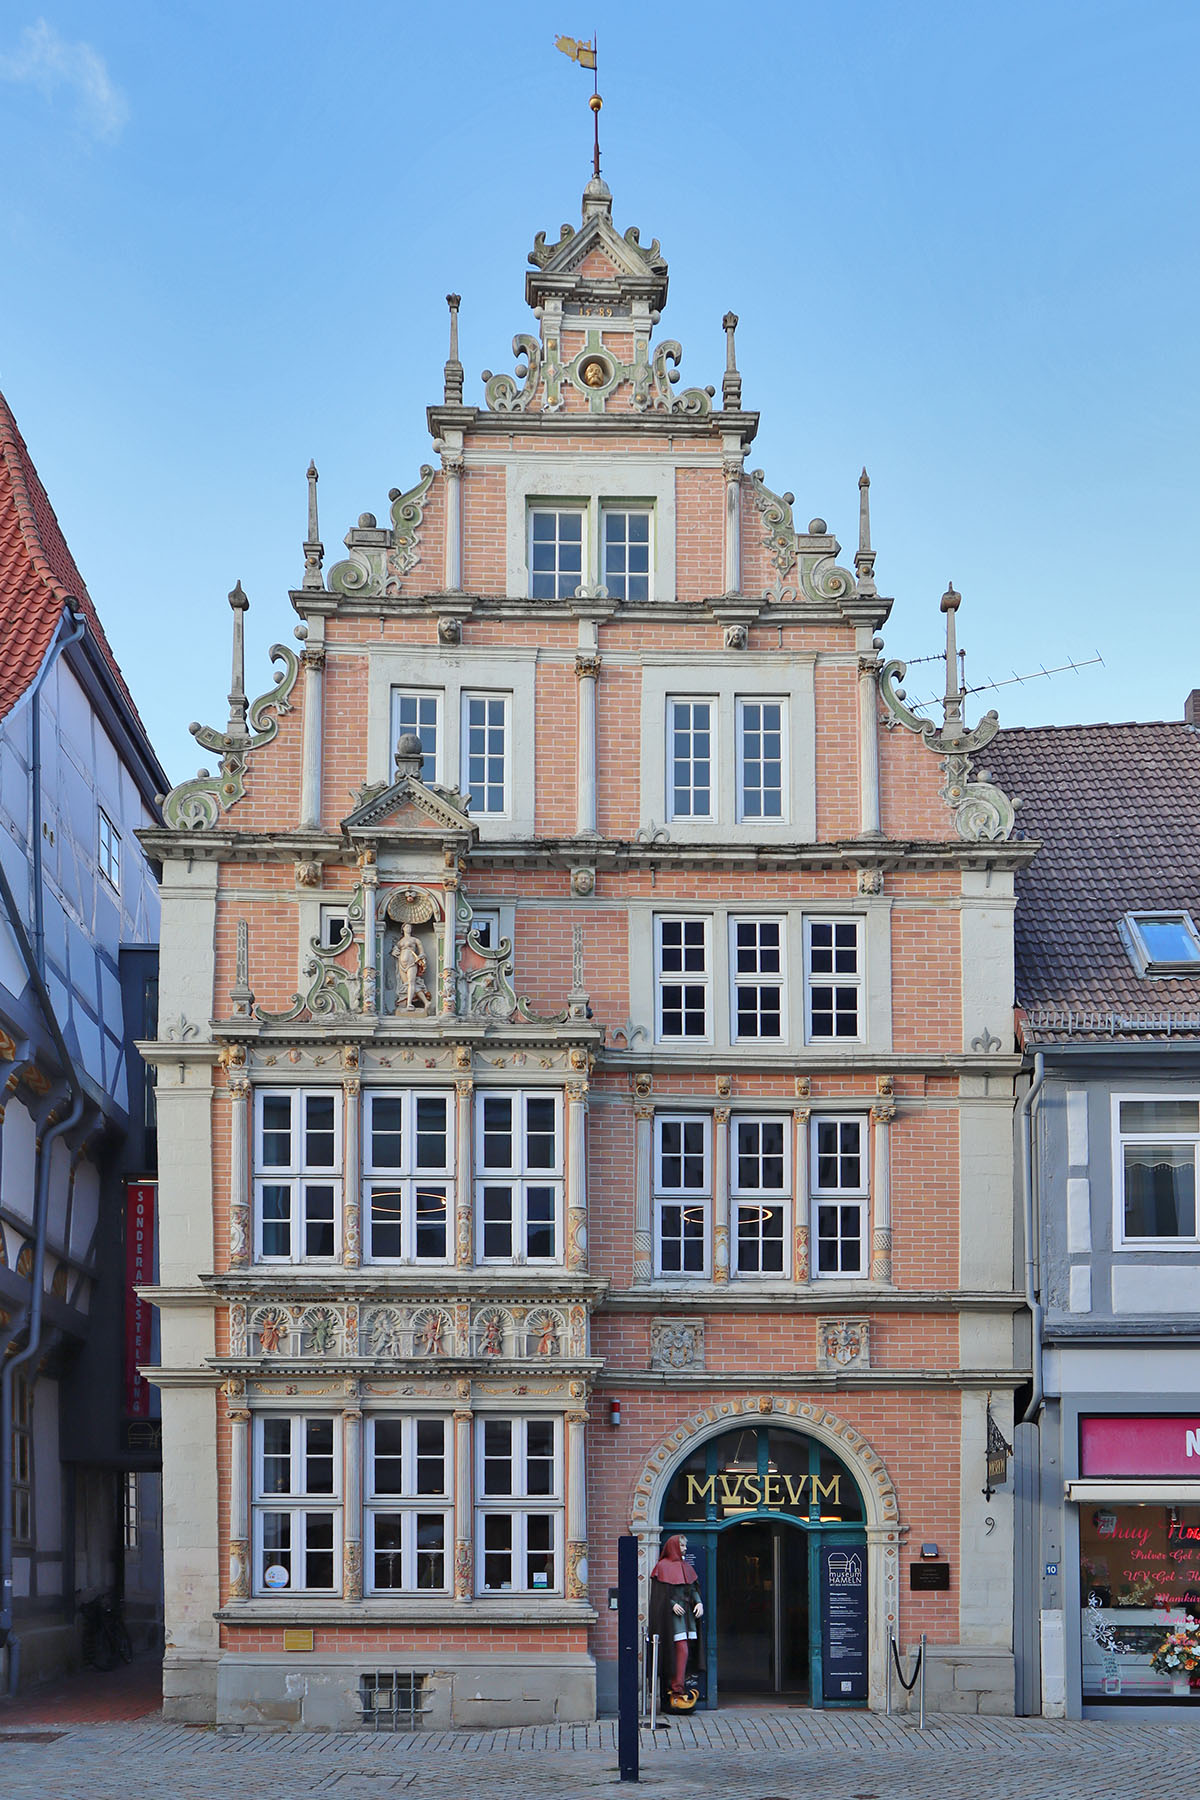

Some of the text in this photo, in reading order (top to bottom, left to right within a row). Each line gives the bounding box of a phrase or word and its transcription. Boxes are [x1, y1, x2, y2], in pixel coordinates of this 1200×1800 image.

[685, 1474, 842, 1505] MVSEVM
[985, 1517, 995, 1536] 9
[1047, 1566, 1056, 1574] 10
